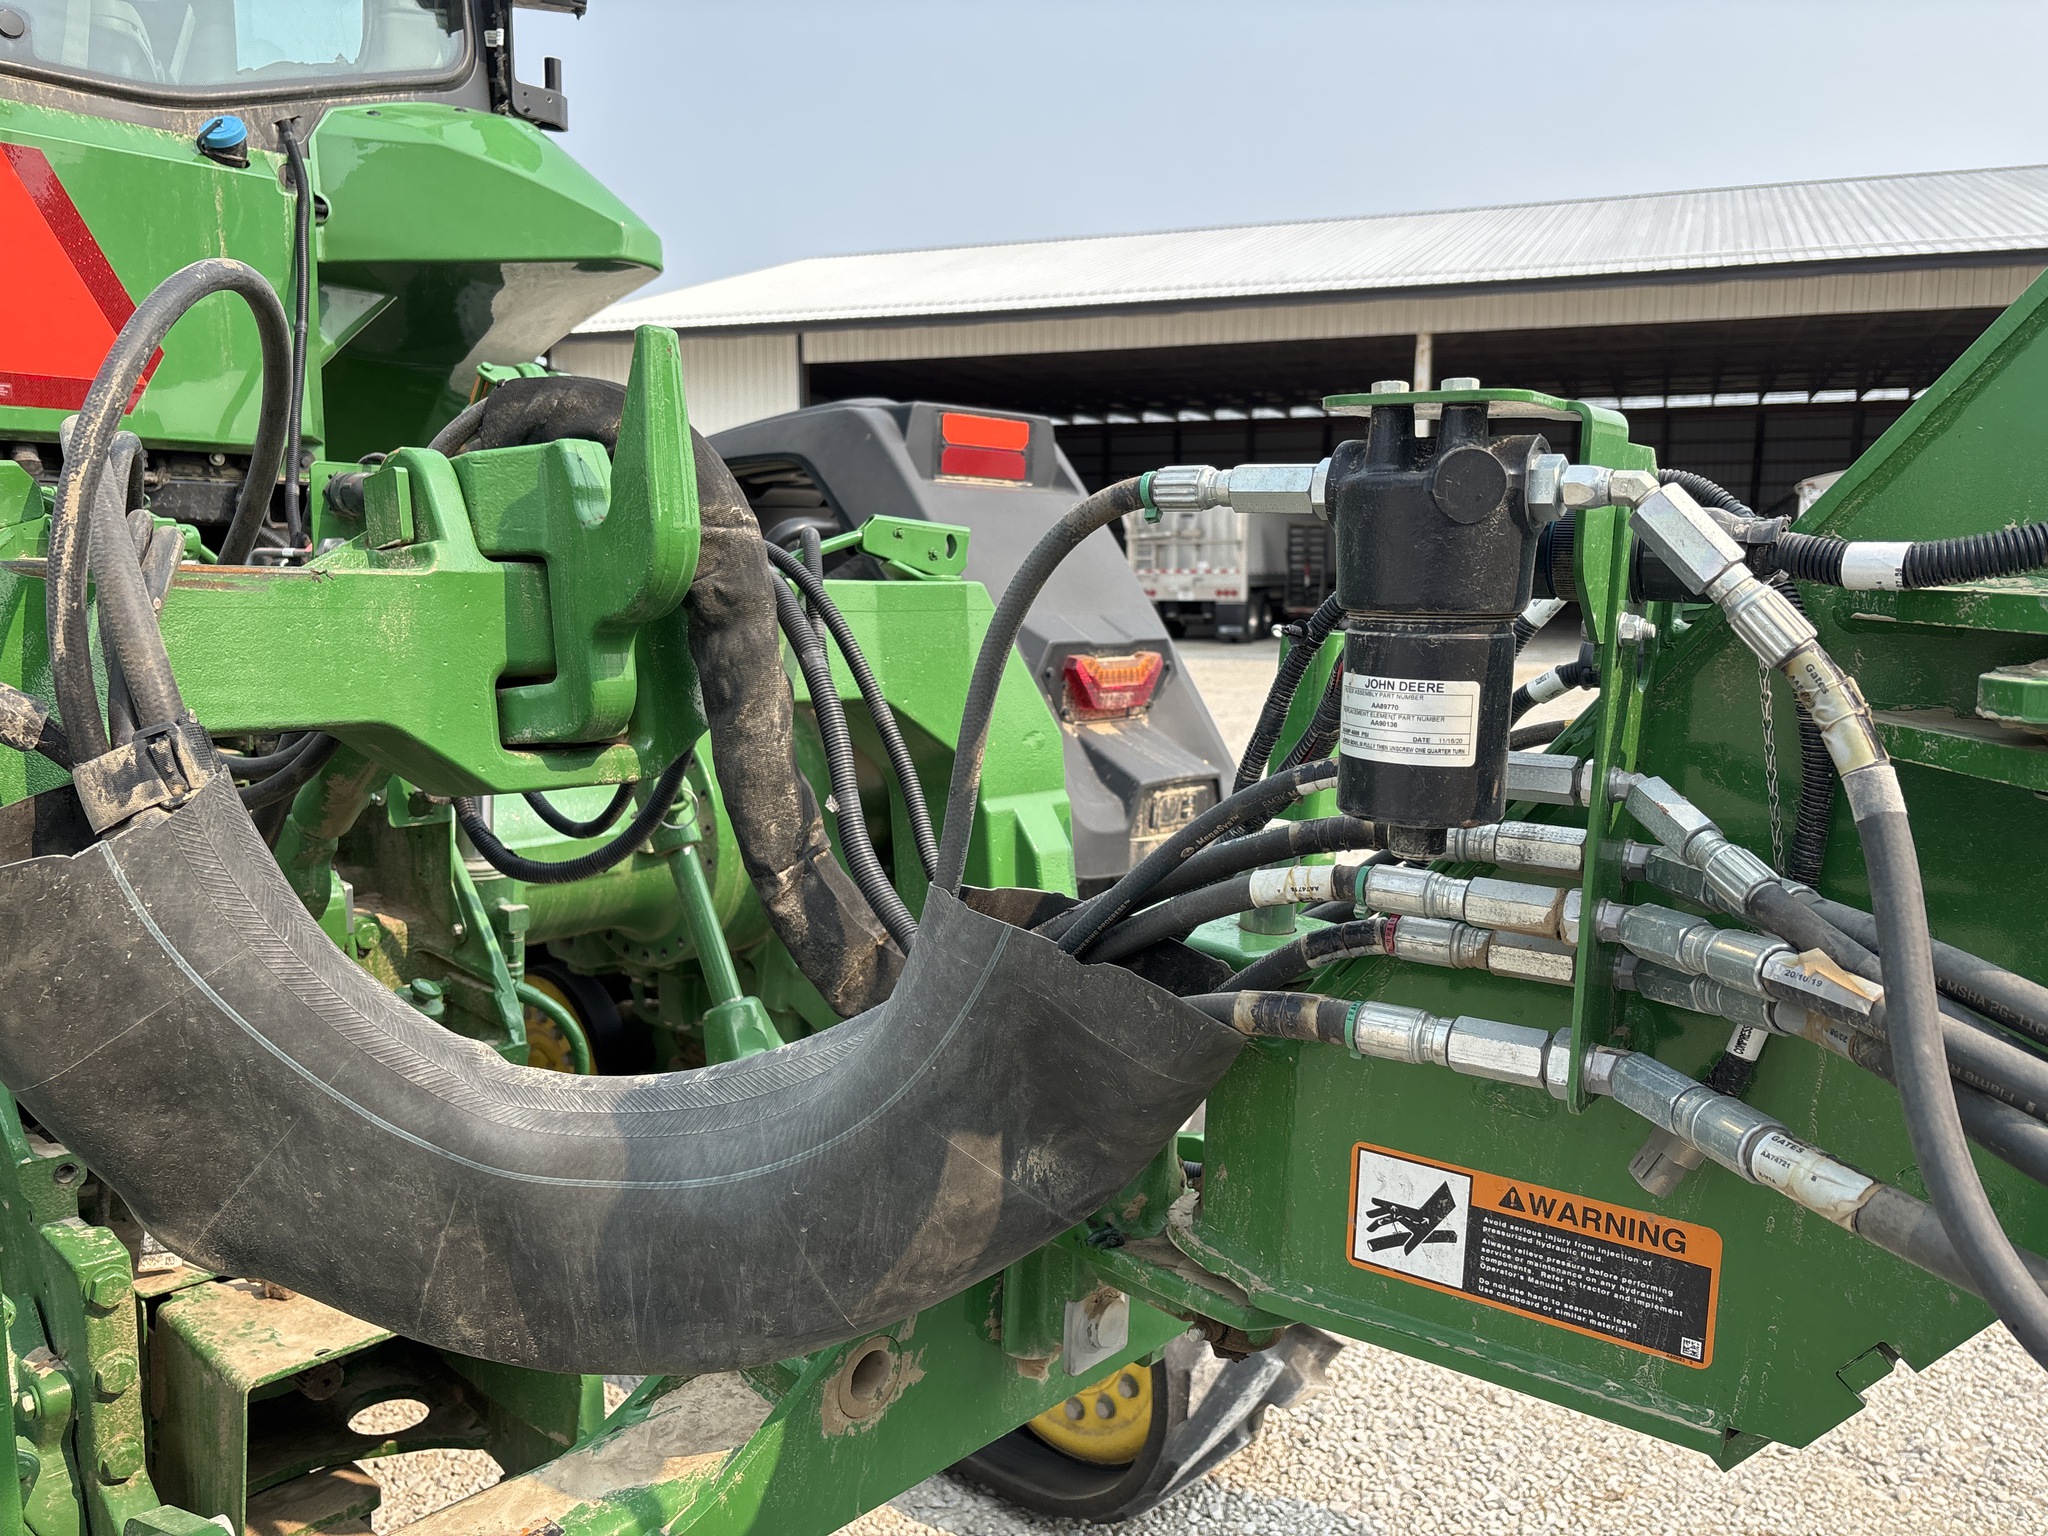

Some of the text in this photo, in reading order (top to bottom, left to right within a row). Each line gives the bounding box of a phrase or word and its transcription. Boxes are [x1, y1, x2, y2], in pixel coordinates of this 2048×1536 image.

[1365, 679, 1444, 693] JOHN DEERE
[1806, 663, 1829, 695] Gates
[1370, 712, 1396, 720] ELEMENT
[1946, 979, 1986, 1008] MSHA
[1965, 1070, 2015, 1102] Flame
[1771, 1134, 1806, 1154] GATES
[1483, 1216, 1507, 1228] Avoid
[1510, 1224, 1542, 1237] serious
[1545, 1233, 1571, 1246] injury
[1575, 1241, 1594, 1252] from
[1598, 1247, 1638, 1263] injection
[1528, 1193, 1687, 1254] WARNING
[1482, 1226, 1604, 1263] pressurized hydraulic fluid.
[1479, 1263, 1566, 1292] Operator's Manuals.
[1480, 1255, 1534, 1274] components.
[1540, 1272, 1564, 1283] Refer
[1580, 1283, 1610, 1296] tractor
[1613, 1294, 1630, 1302] and
[1634, 1298, 1683, 1317] implement
[1481, 1247, 1511, 1260] service
[1527, 1259, 1583, 1280] maintenance
[1586, 1276, 1596, 1284] on
[1600, 1280, 1616, 1290] any
[1620, 1285, 1664, 1302] hydraulic
[1482, 1238, 1674, 1297] Always relieve pressure before performing
[1478, 1277, 1490, 1286] Do
[1493, 1282, 1506, 1291] not
[1510, 1287, 1524, 1295] use
[1528, 1292, 1548, 1303] hand
[1564, 1303, 1594, 1316] search
[1597, 1312, 1609, 1321] for
[1613, 1317, 1640, 1329] leaks.
[1478, 1285, 1494, 1295] Use
[1496, 1291, 1540, 1308] cardboard
[1555, 1308, 1586, 1322] similar
[1590, 1319, 1629, 1335] material.
